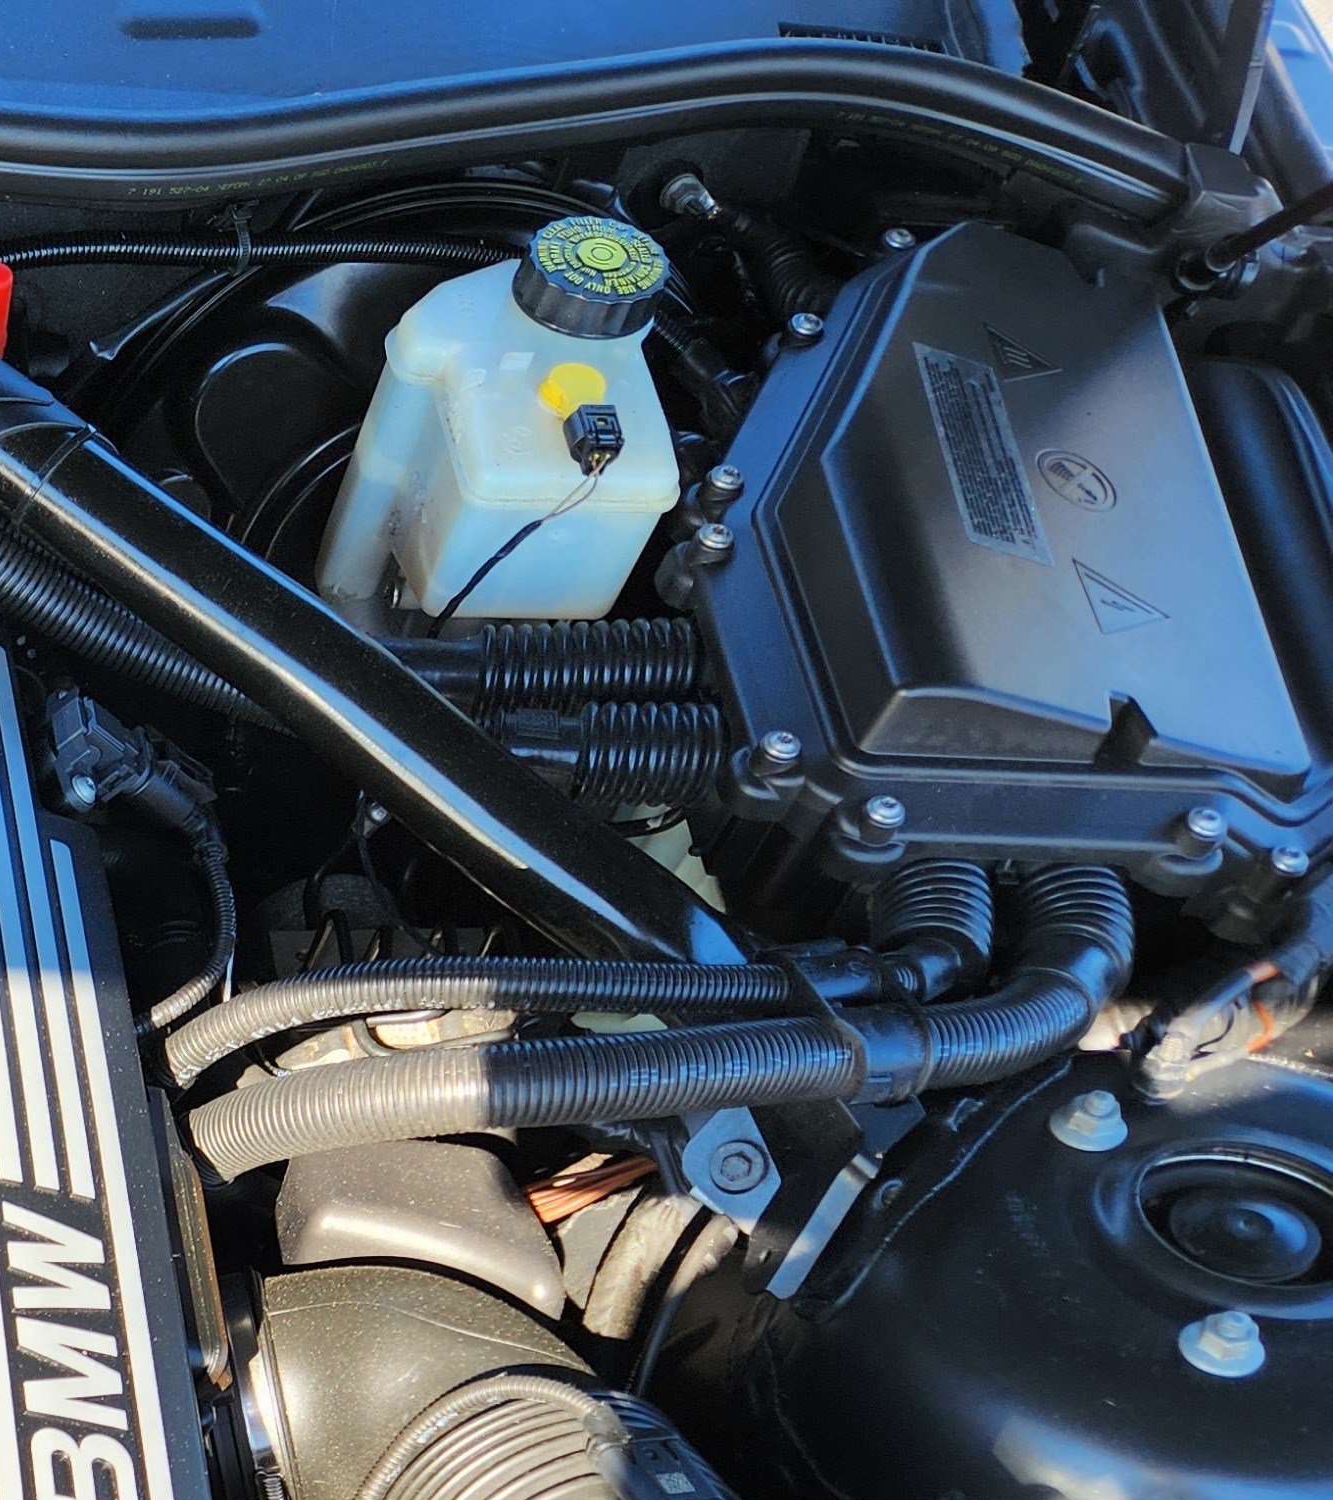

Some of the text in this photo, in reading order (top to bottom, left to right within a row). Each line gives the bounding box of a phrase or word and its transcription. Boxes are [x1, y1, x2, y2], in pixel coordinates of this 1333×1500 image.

[564, 271, 585, 285] DOT
[584, 281, 611, 294] ONLY
[615, 284, 637, 295] USE
